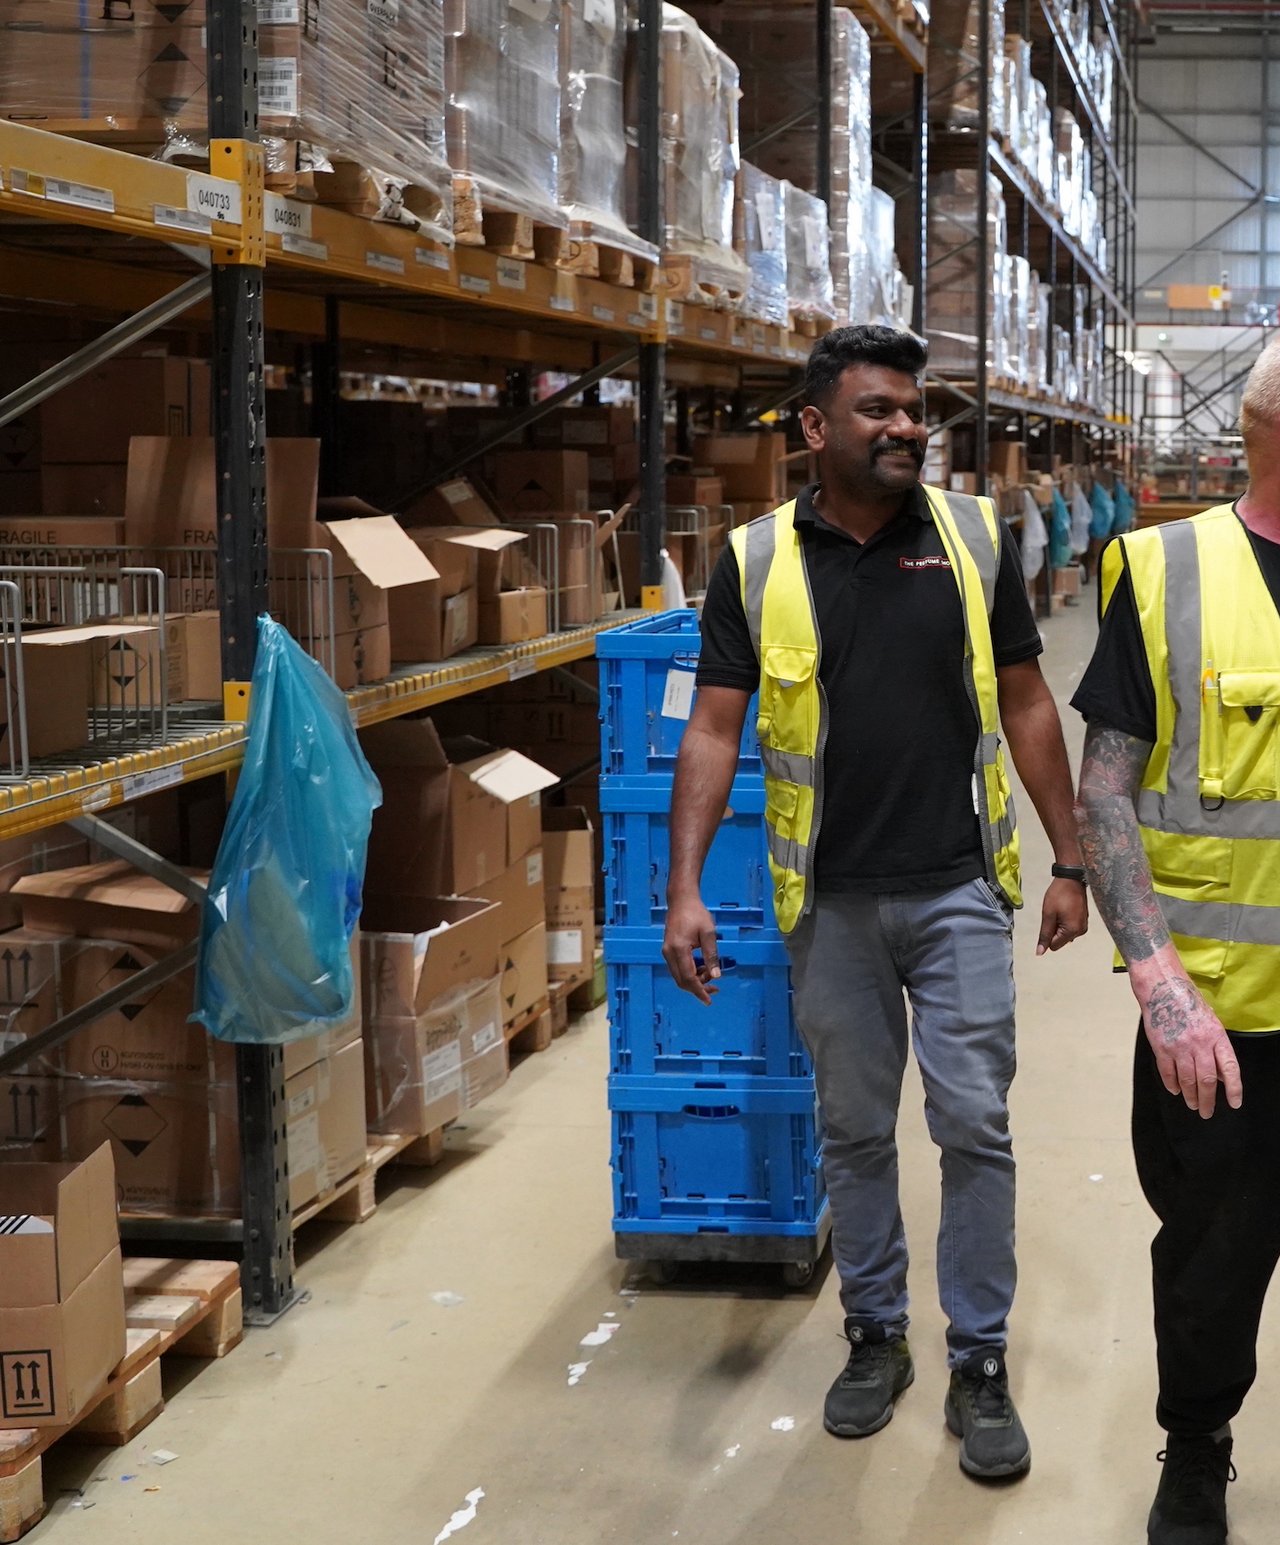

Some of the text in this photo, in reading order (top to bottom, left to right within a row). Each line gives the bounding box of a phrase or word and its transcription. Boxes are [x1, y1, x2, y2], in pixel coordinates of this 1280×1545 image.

[199, 189, 230, 210] 040733
[274, 208, 301, 228] 040831
[915, 559, 940, 567] PERFUME
